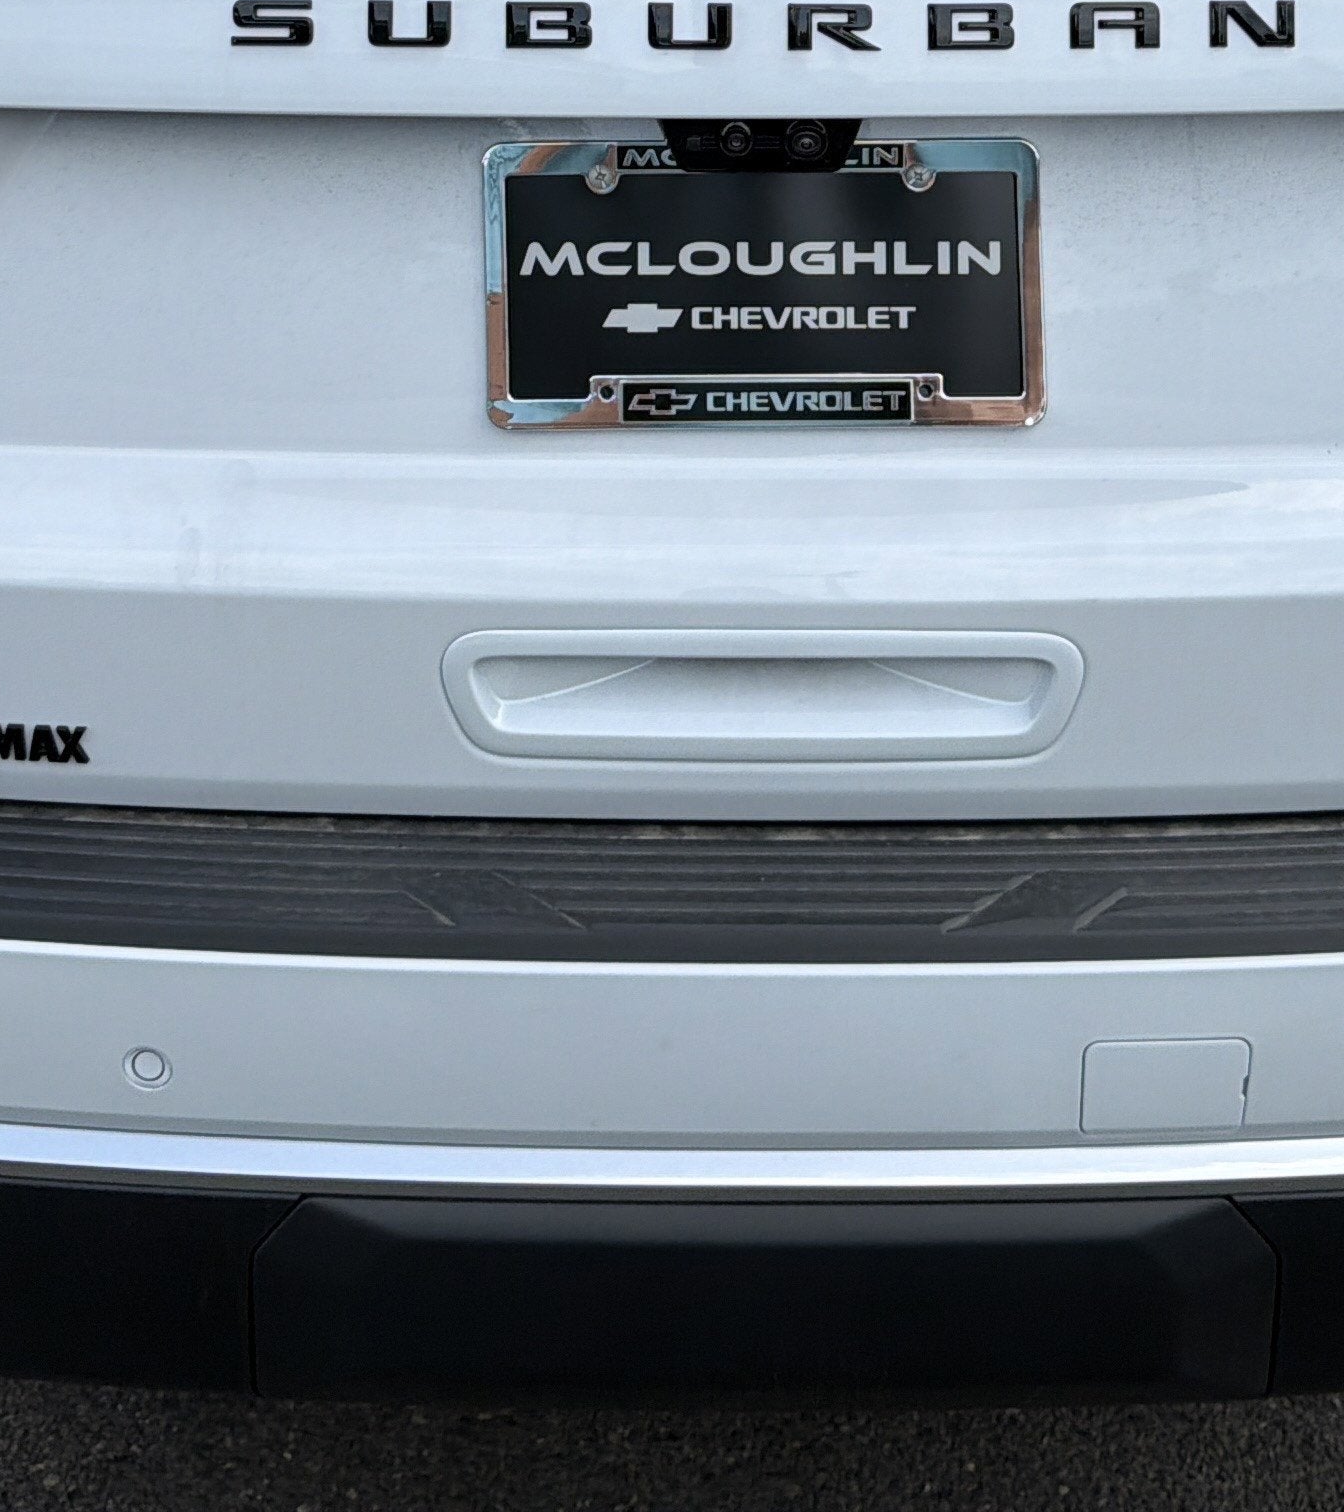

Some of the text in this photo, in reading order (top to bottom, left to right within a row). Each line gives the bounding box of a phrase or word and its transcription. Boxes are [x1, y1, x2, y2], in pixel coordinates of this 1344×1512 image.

[518, 240, 1003, 277] MCLOUGHLIN
[690, 305, 917, 331] CHEVROLET
[705, 390, 907, 414] CHEVROLET
